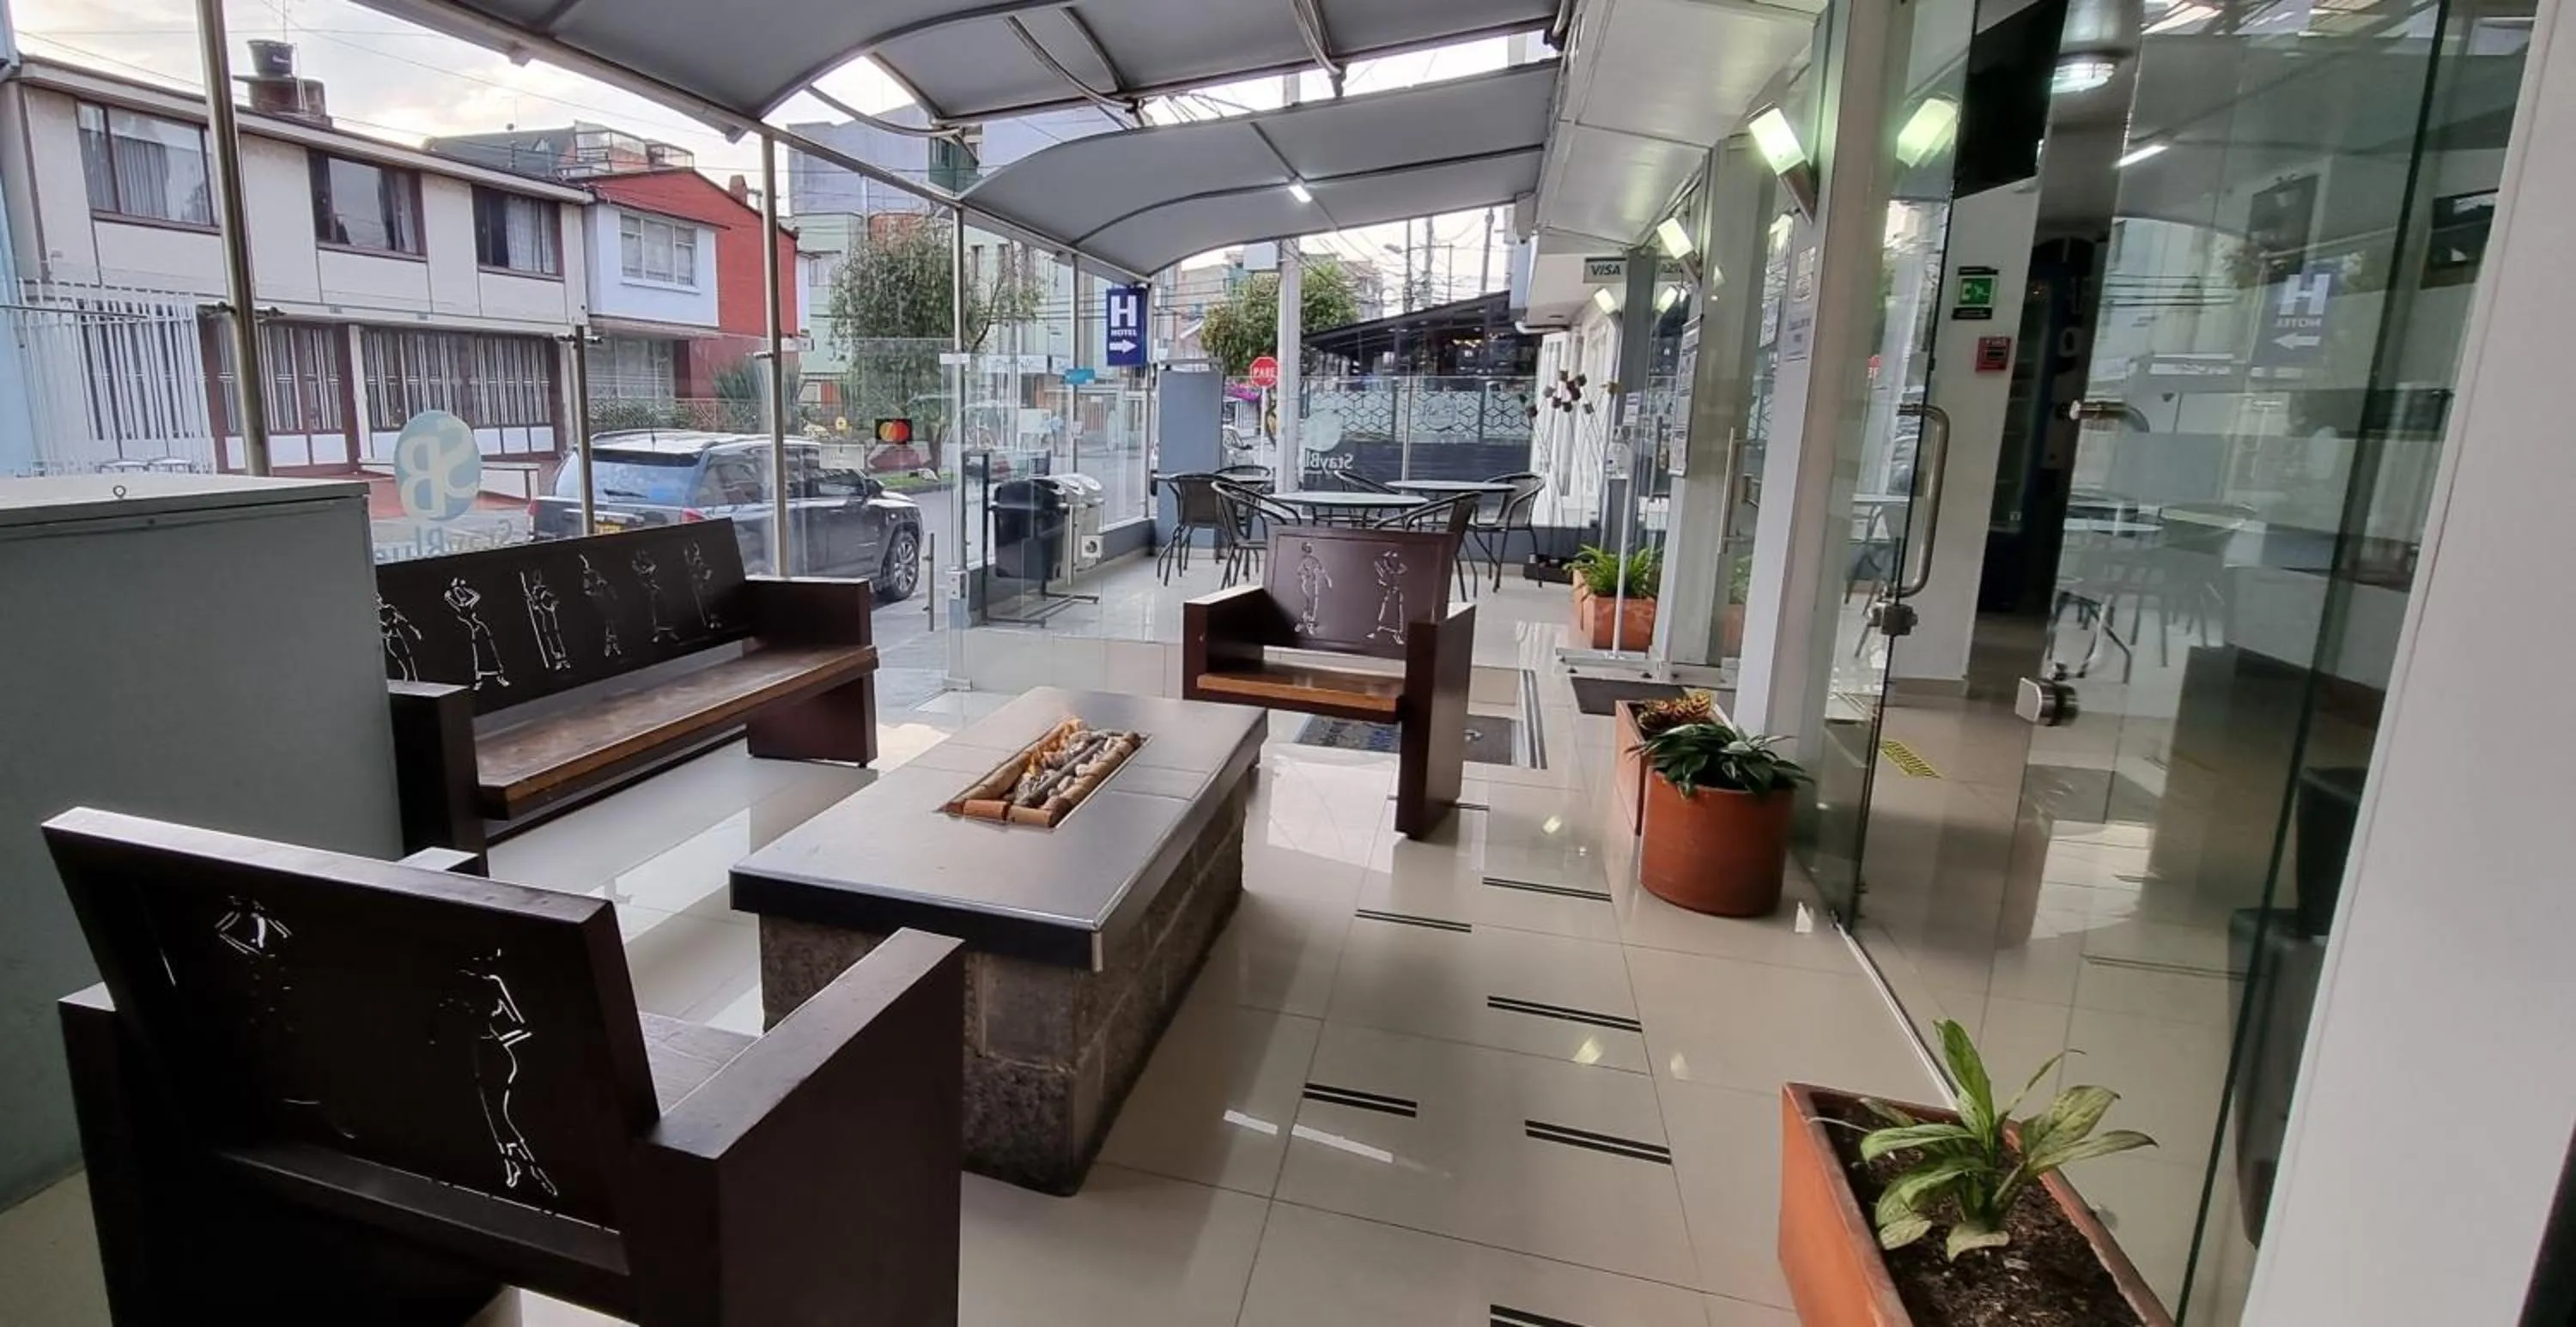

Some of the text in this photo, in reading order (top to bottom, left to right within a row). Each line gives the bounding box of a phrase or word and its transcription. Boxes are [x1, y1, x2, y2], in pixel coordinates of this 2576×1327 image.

[1590, 264, 1621, 276] VISA
[1111, 295, 1136, 327] H
[1110, 329, 1137, 337] HOTEL
